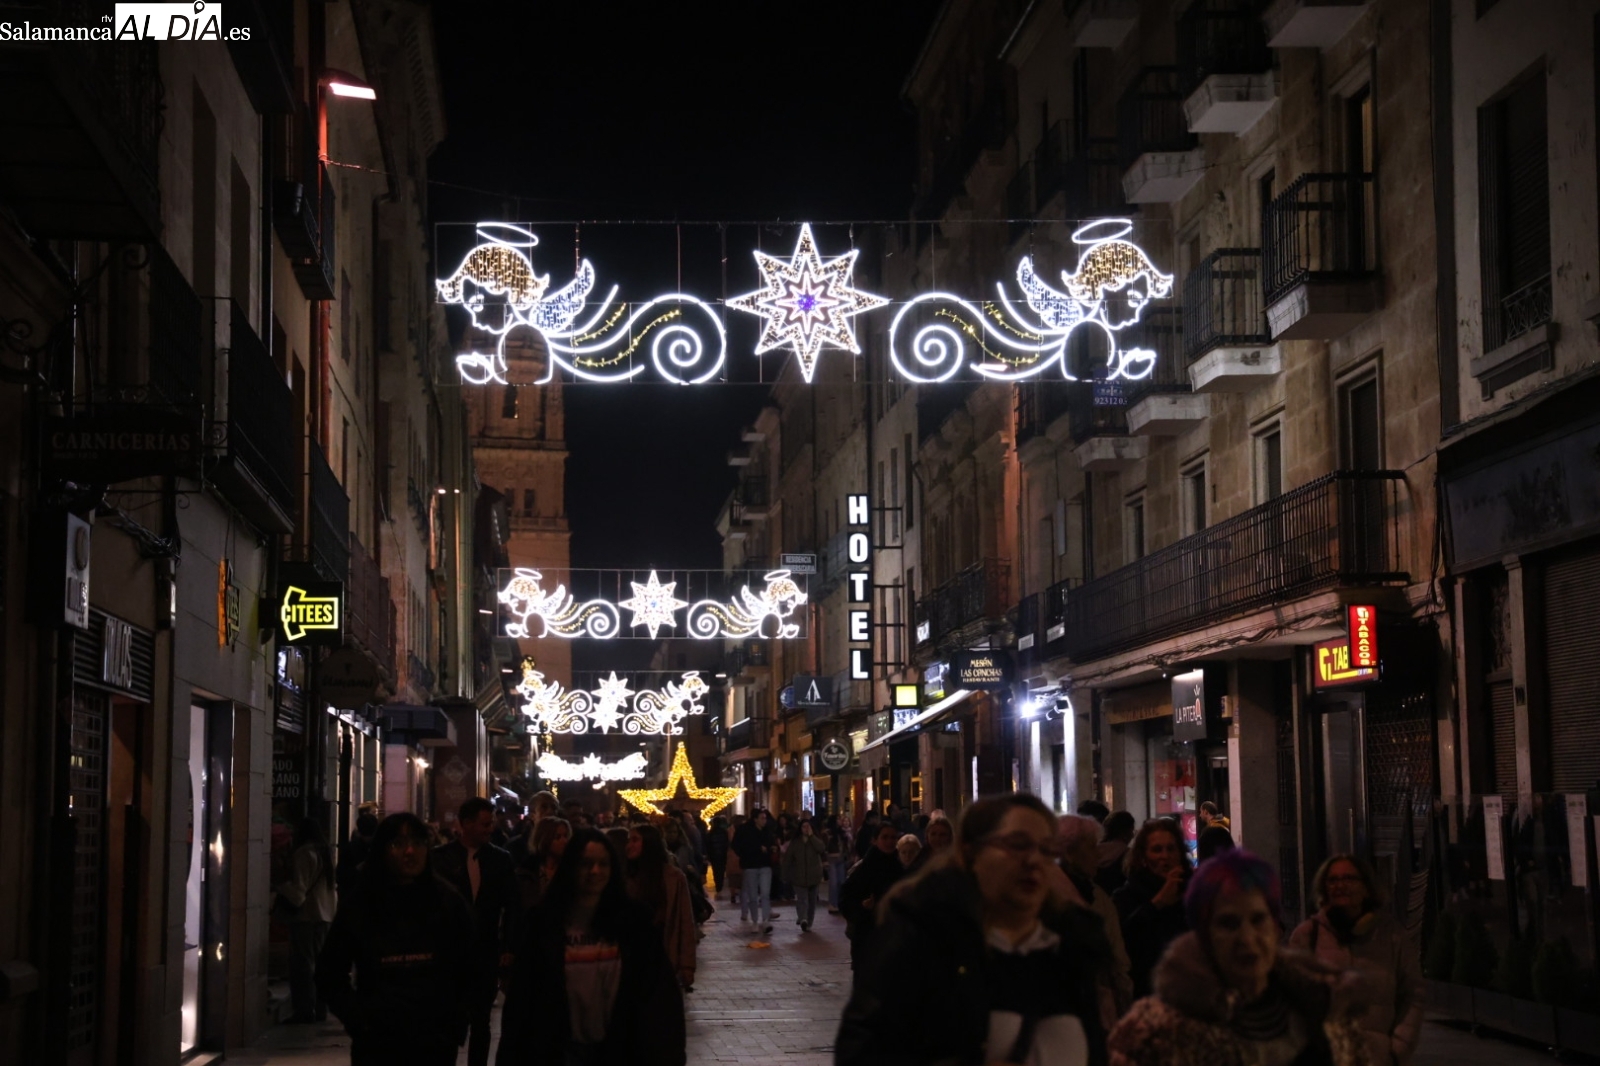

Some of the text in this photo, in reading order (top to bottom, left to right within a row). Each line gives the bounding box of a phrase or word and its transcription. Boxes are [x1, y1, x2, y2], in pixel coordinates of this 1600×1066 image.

[51, 427, 191, 451] CARNICERÍAS
[848, 495, 869, 680] HOTEL
[281, 603, 333, 623] CITEES
[1357, 617, 1371, 666] TABACOS
[1332, 645, 1349, 672] TAB
[960, 668, 973, 678] LAS
[1175, 707, 1183, 724] LA
